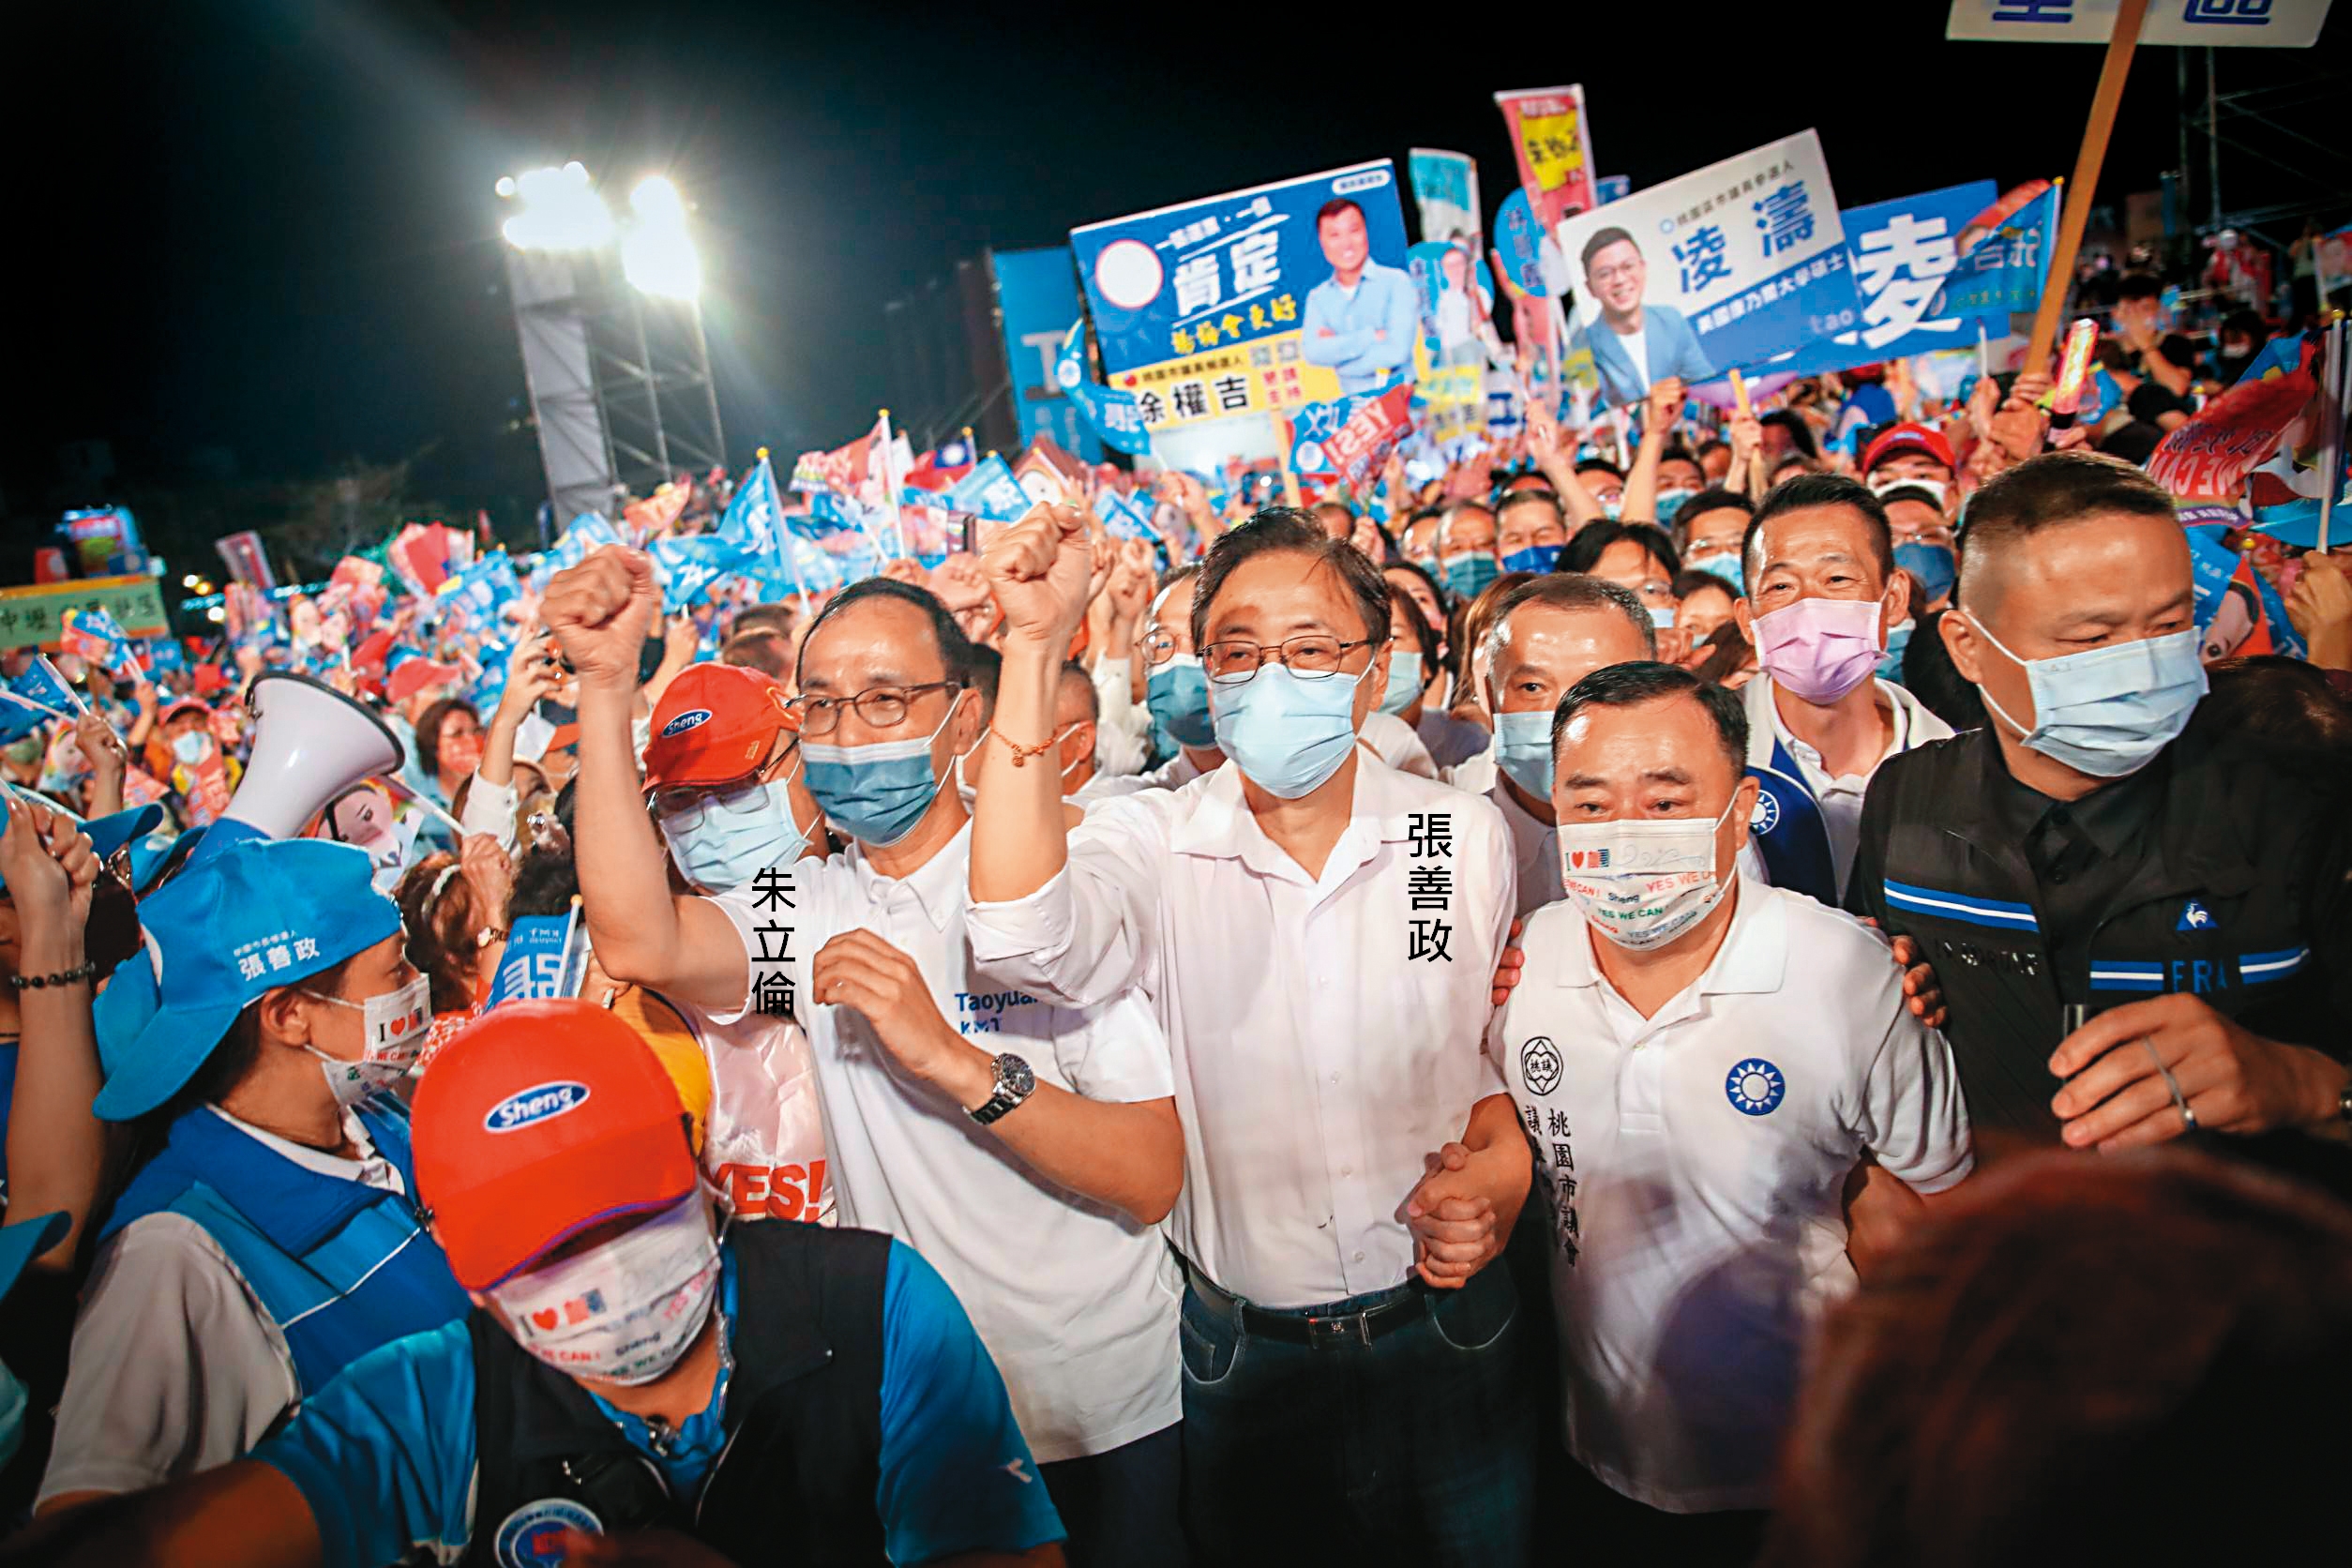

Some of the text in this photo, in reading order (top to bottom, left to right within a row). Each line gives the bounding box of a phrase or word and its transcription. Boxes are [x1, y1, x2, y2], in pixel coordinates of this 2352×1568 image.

[1671, 179, 1815, 294] 凌濤
[1172, 231, 1281, 317] 肯定
[1139, 375, 1250, 424] 余權吉
[667, 712, 703, 735] Sheng
[1646, 877, 1675, 893] YES
[237, 937, 321, 982] 張善政
[954, 990, 1038, 1014] Taoyua
[498, 1086, 574, 1127] Sheng
